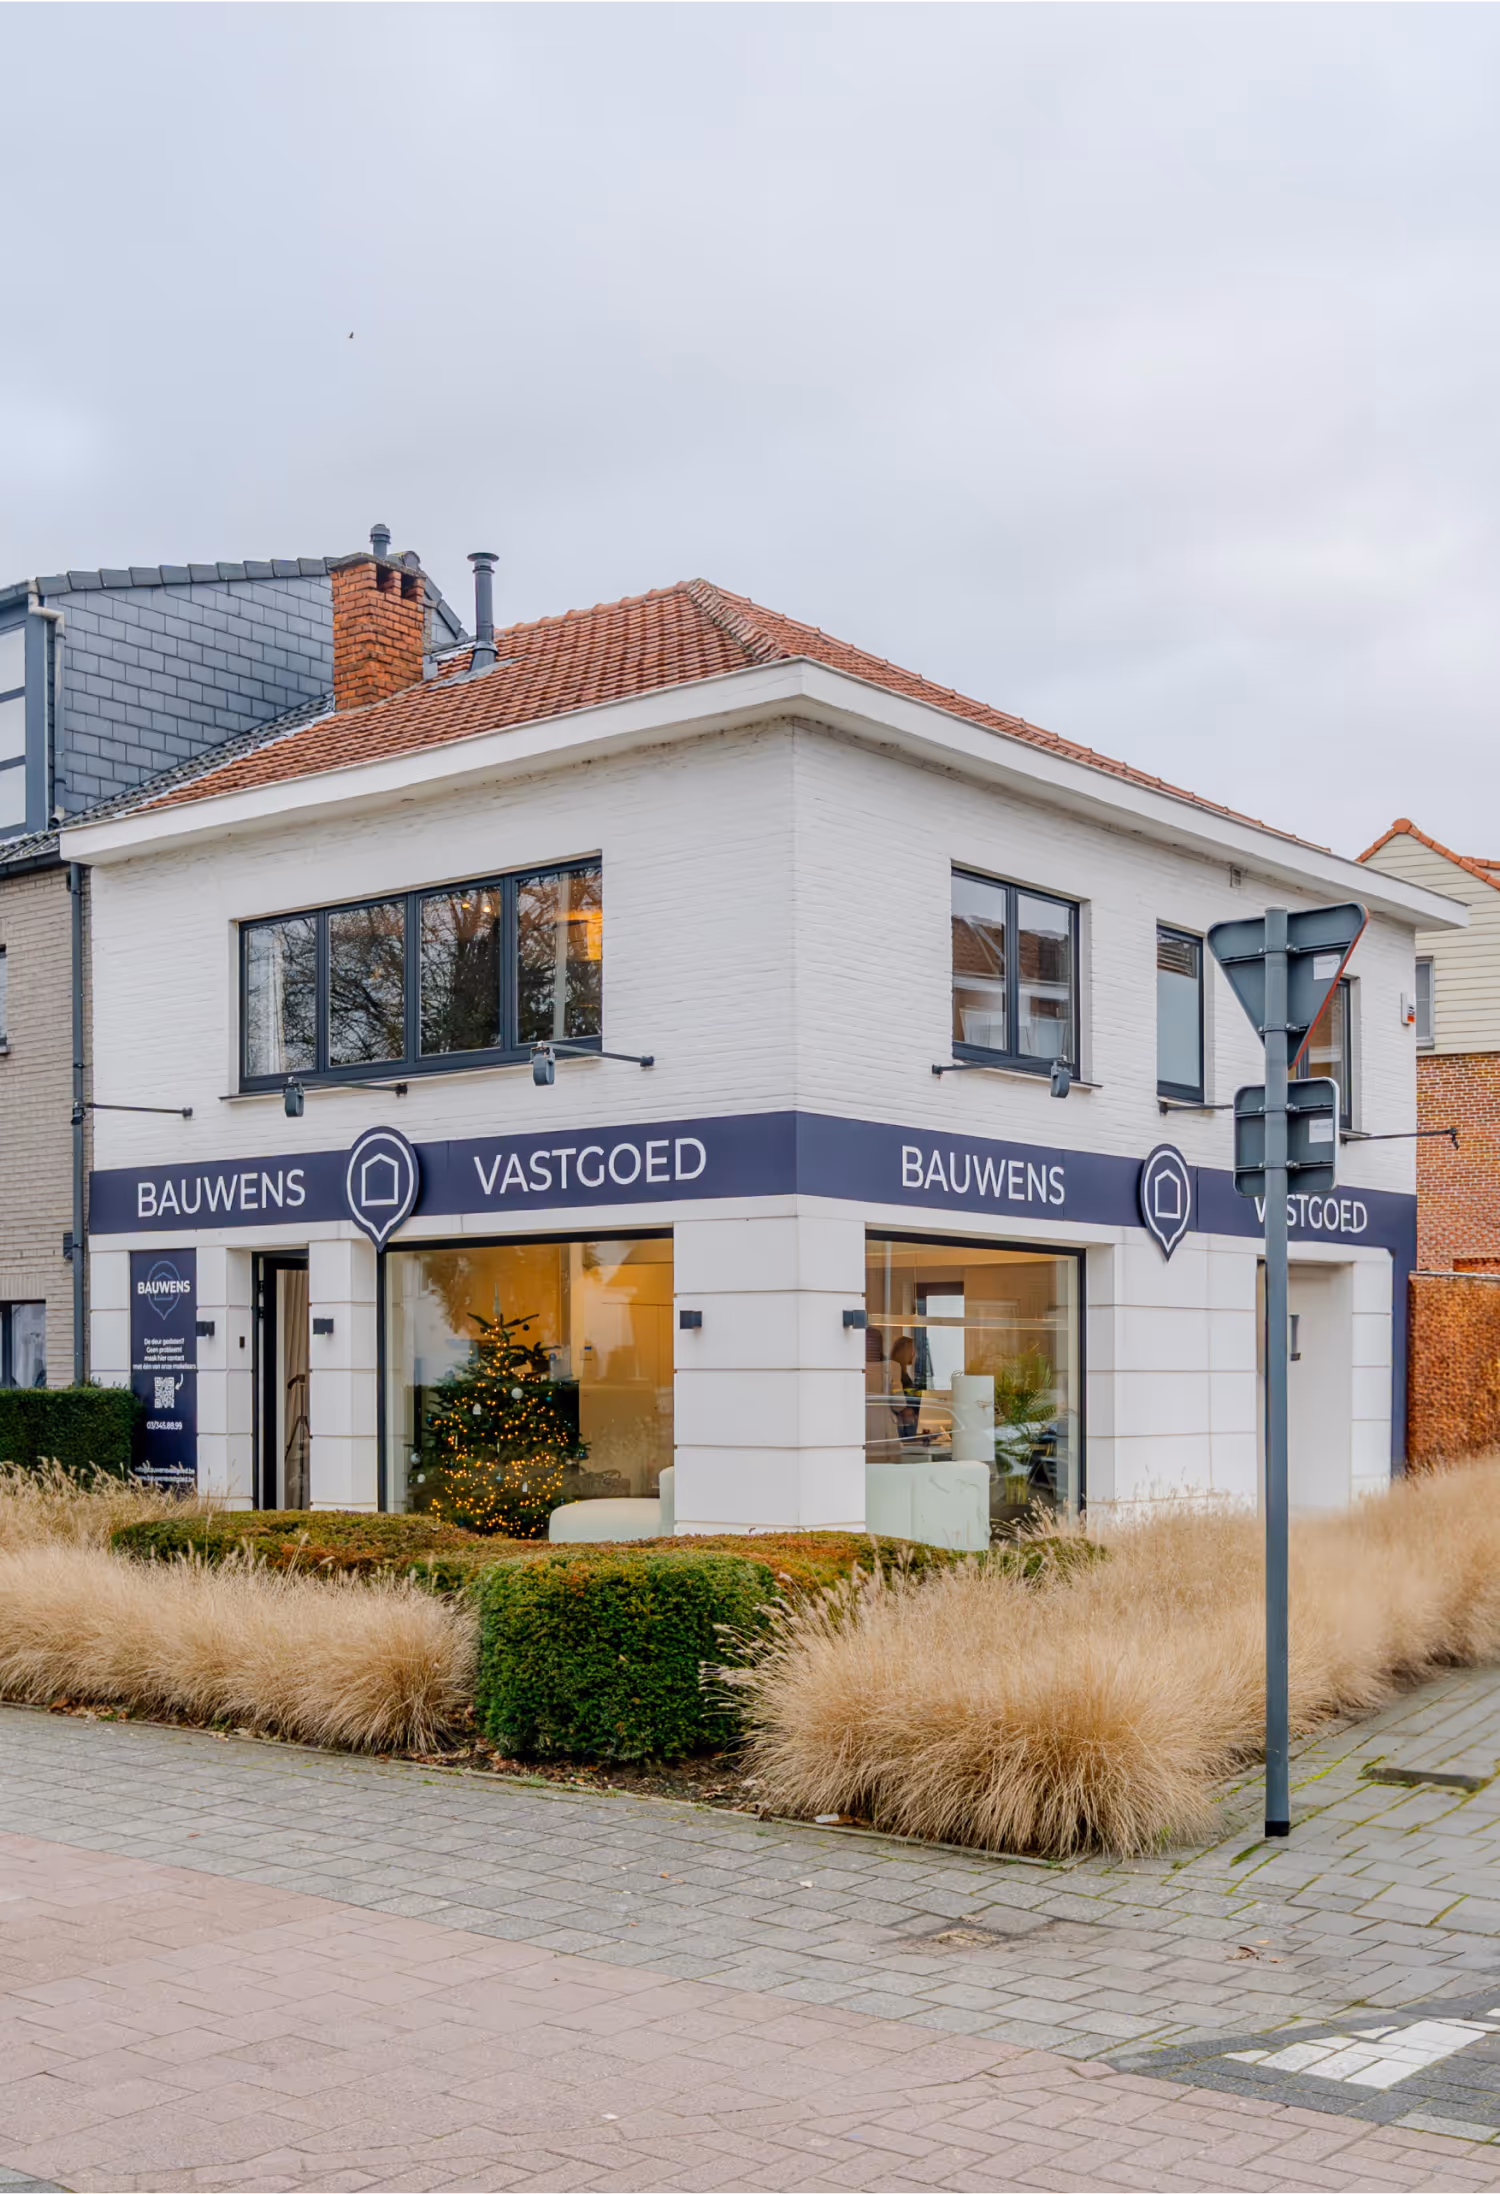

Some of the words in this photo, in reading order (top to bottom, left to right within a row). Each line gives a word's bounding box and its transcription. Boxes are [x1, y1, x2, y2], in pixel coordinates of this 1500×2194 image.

[137, 1169, 306, 1218] BAUWENS
[473, 1137, 707, 1195] VASTGOED
[901, 1145, 1066, 1205] BAUWENS
[1254, 1193, 1369, 1234] VSTGOED
[138, 1280, 190, 1294] BAUWENS
